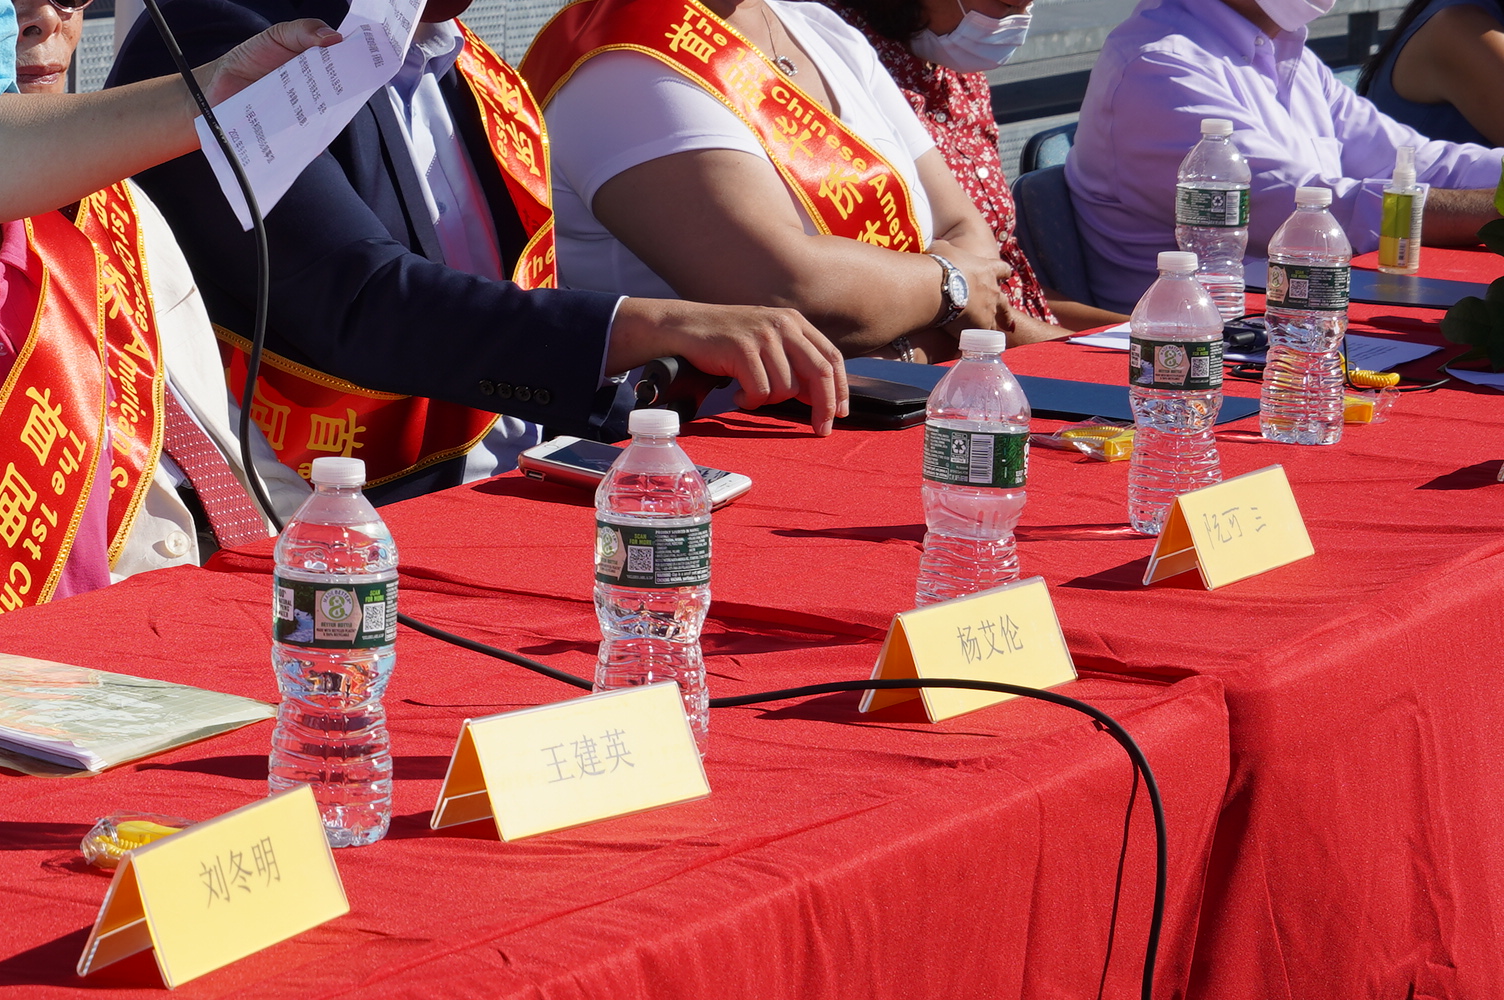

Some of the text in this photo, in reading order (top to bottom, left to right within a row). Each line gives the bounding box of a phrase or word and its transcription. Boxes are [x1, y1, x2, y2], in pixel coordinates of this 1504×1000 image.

[683, 4, 728, 47] The
[736, 47, 767, 85] 1st
[771, 85, 868, 173] Chinese
[111, 330, 150, 457] American
[51, 430, 87, 495] The
[22, 503, 57, 561] 1st
[956, 614, 1024, 664] 杨艾伦
[540, 728, 635, 784] 王建英
[199, 836, 281, 909] 刘冬明
